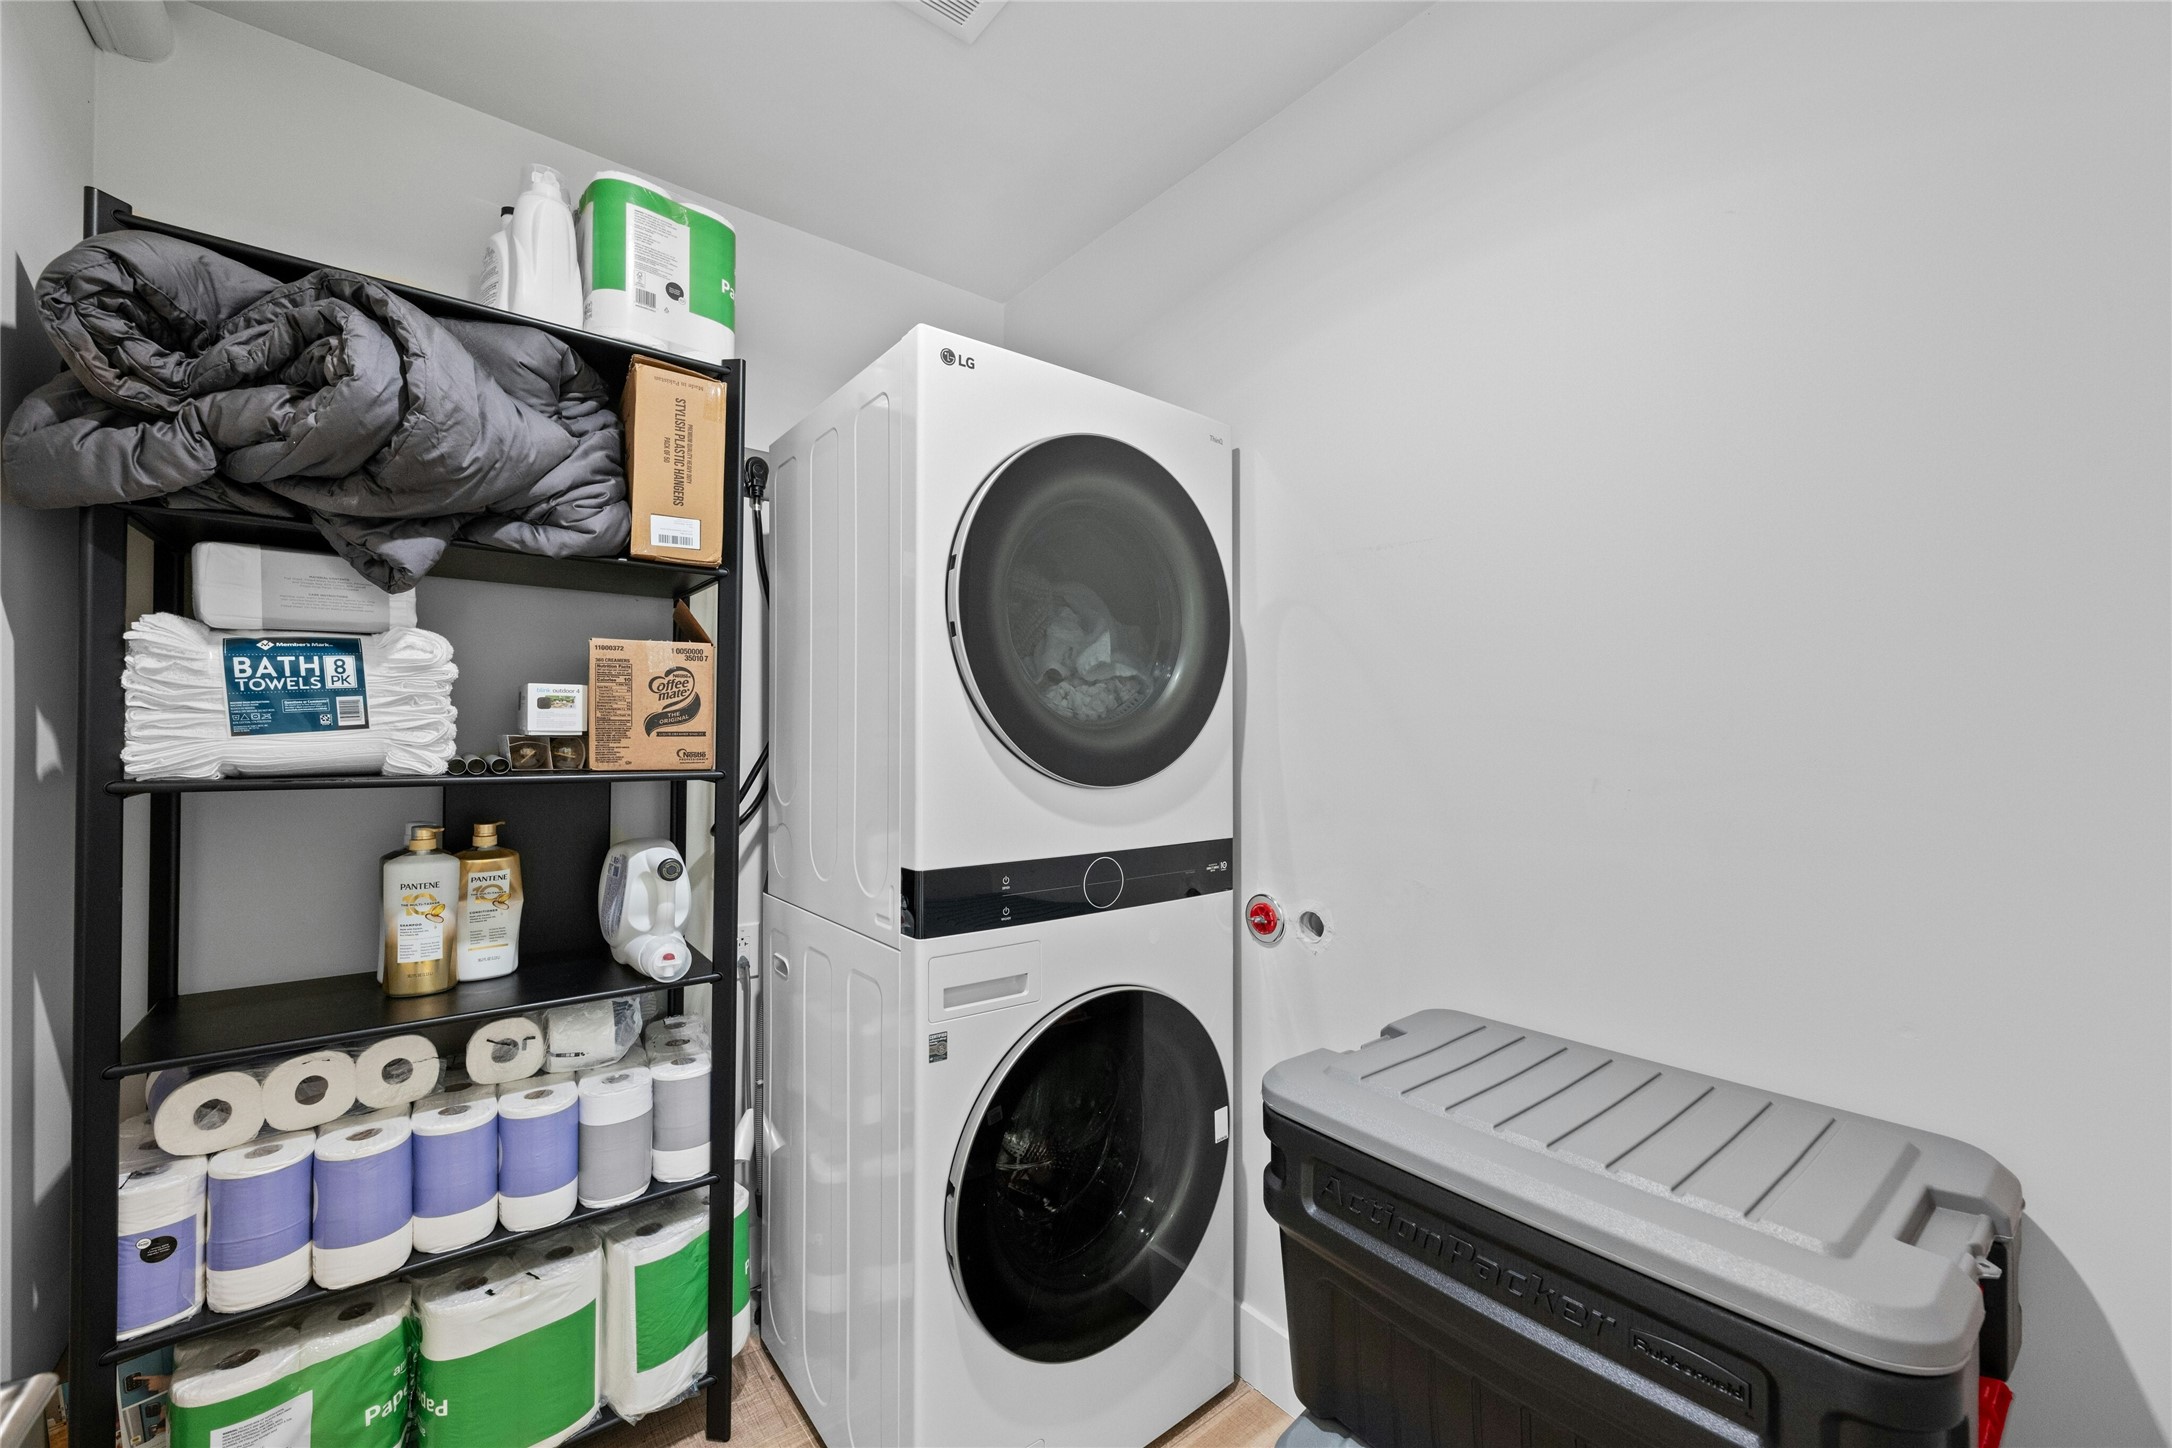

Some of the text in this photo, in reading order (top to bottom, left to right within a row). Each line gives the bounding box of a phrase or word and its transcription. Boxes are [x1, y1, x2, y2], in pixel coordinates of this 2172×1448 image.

[958, 354, 975, 370] LG
[688, 383, 704, 391] Made
[663, 437, 671, 450] PACK
[673, 397, 686, 507] STYLISH PLASTIC HANGERS
[663, 456, 671, 464] 50
[675, 648, 704, 656] 0050000
[232, 656, 347, 678] BATH 8
[234, 675, 352, 692] TOWELS PK
[648, 675, 690, 694] Coffee
[658, 688, 687, 702] mate
[659, 714, 689, 725] ORIGINAL
[470, 874, 508, 883] PANTENE
[400, 881, 441, 891] PANTENE
[1320, 1176, 1617, 1336] ActionPacker
